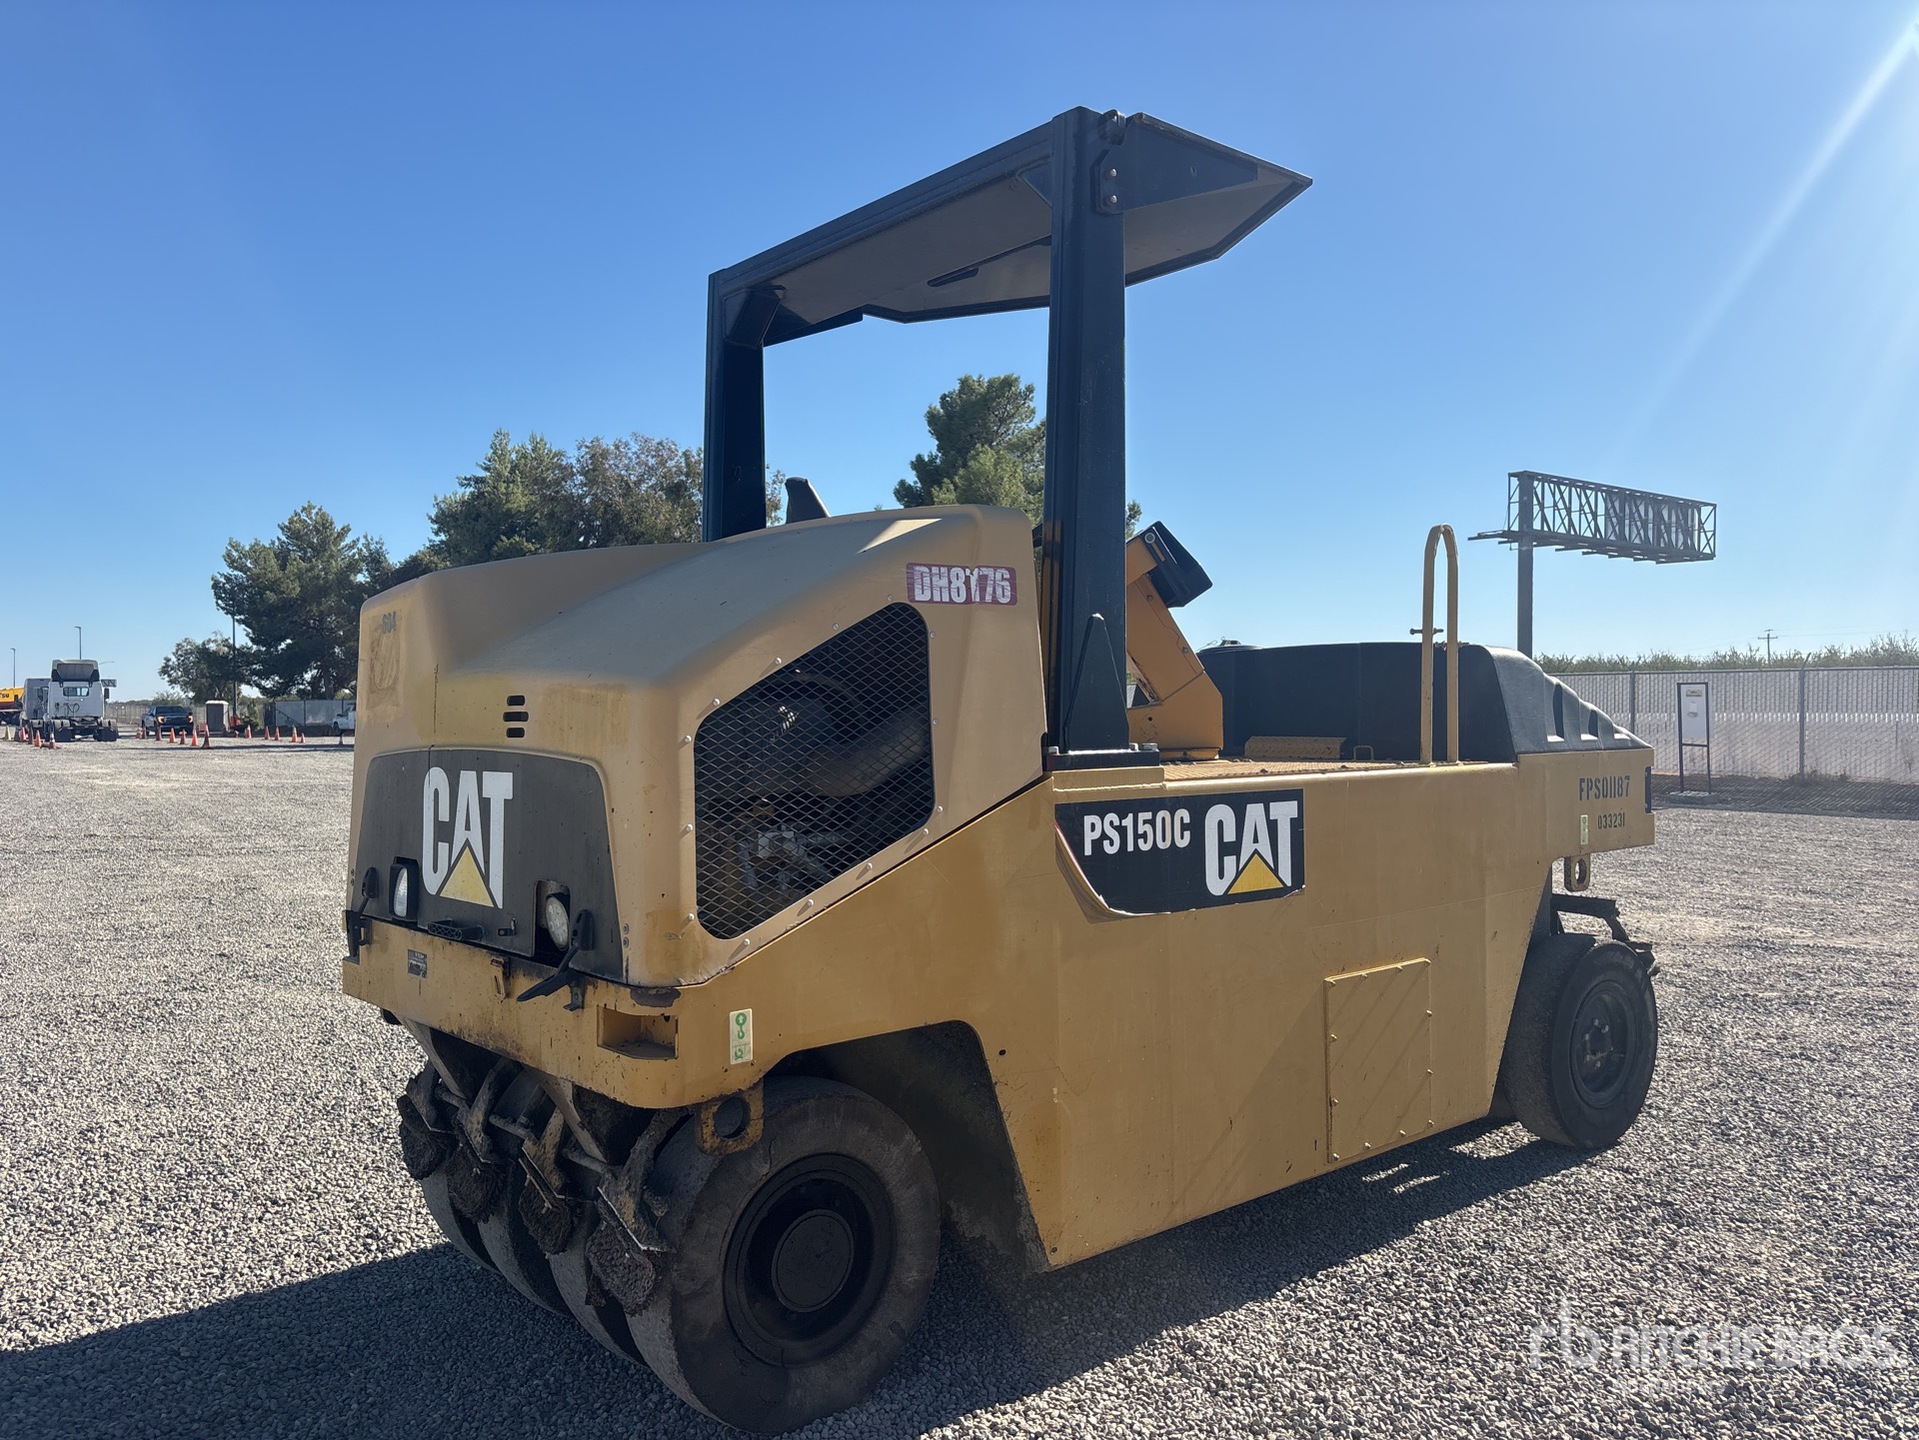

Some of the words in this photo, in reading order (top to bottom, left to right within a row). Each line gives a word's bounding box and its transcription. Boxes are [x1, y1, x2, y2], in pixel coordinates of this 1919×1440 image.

[912, 565, 1012, 604] DH8Y76
[422, 766, 514, 909] CAT
[1084, 808, 1191, 856] PS150C
[1204, 800, 1298, 896] CAT
[1597, 812, 1626, 829] 033231
